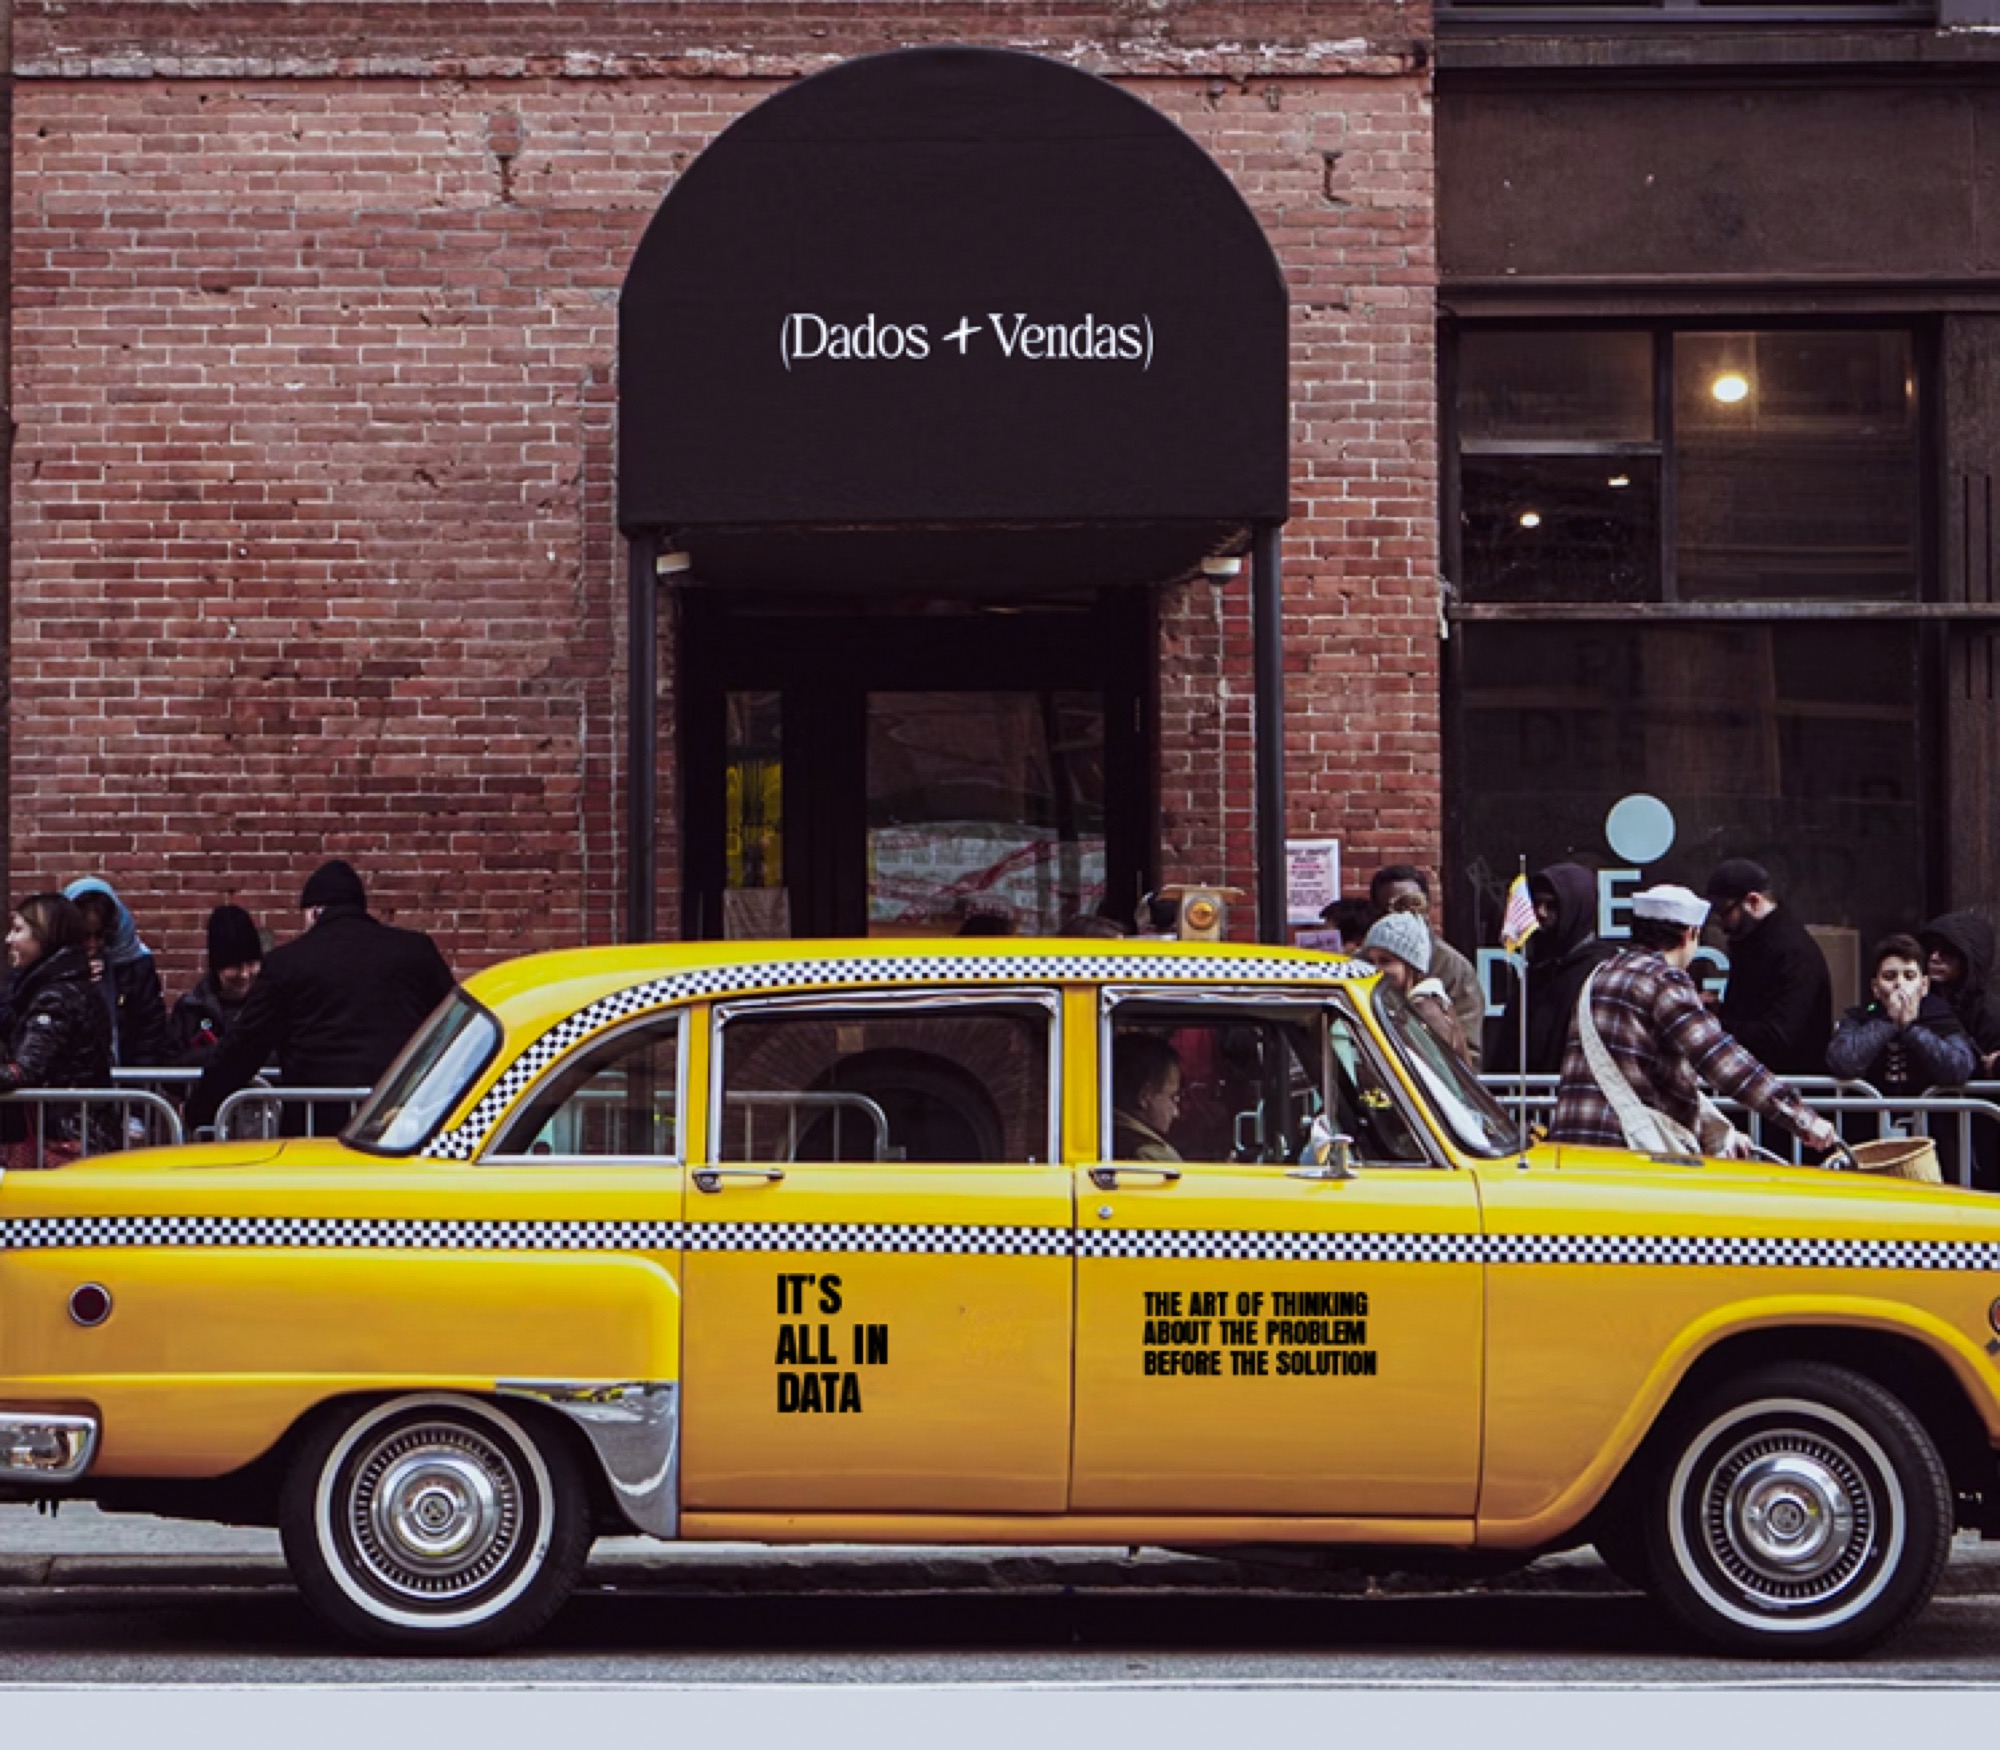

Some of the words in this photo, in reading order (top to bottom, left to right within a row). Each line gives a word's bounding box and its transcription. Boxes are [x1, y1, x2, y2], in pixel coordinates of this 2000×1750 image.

[780, 312, 931, 371] (Dados
[986, 312, 1154, 371] Vendas)
[777, 1274, 843, 1315] IT'S
[1144, 1291, 1183, 1317] THE
[1189, 1291, 1229, 1317] ART
[1236, 1291, 1264, 1317] OF
[1271, 1291, 1368, 1317] THINKING
[774, 1323, 838, 1365] ALL
[854, 1323, 888, 1365] IN
[1143, 1320, 1212, 1346] ABOUT
[1219, 1320, 1258, 1346] THE
[1266, 1320, 1366, 1346] PROBLEM
[1144, 1350, 1222, 1376] BEFORE
[1230, 1350, 1269, 1376] THE
[1275, 1350, 1377, 1376] SOLUTION
[777, 1371, 862, 1413] DATA
